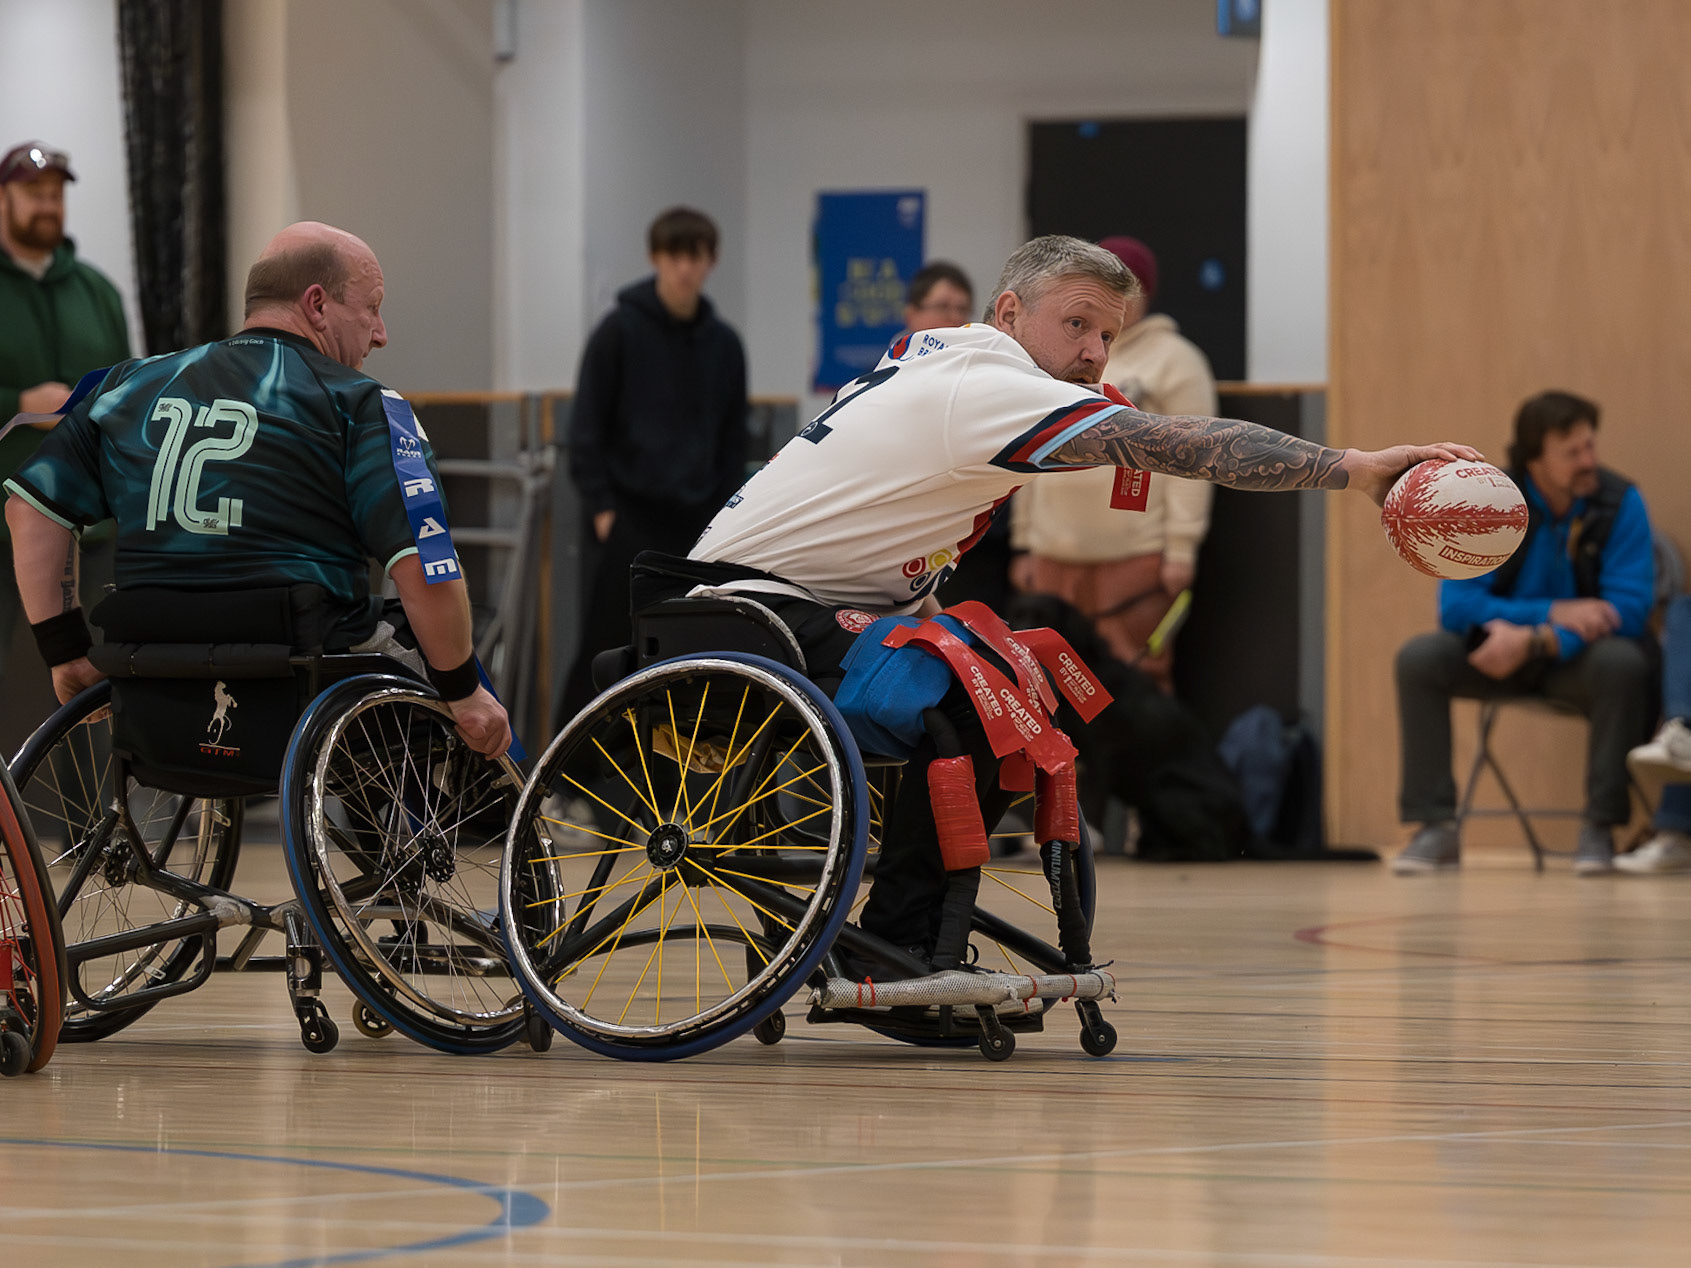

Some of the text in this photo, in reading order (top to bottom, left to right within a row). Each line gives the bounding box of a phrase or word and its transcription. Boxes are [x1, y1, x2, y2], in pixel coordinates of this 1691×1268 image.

[923, 334, 948, 350] ROYA
[146, 397, 259, 536] 12
[970, 665, 1003, 717] CREATED
[1058, 652, 1096, 696] CREATED
[1059, 667, 1069, 676] BY
[1000, 688, 1042, 735] CREATED
